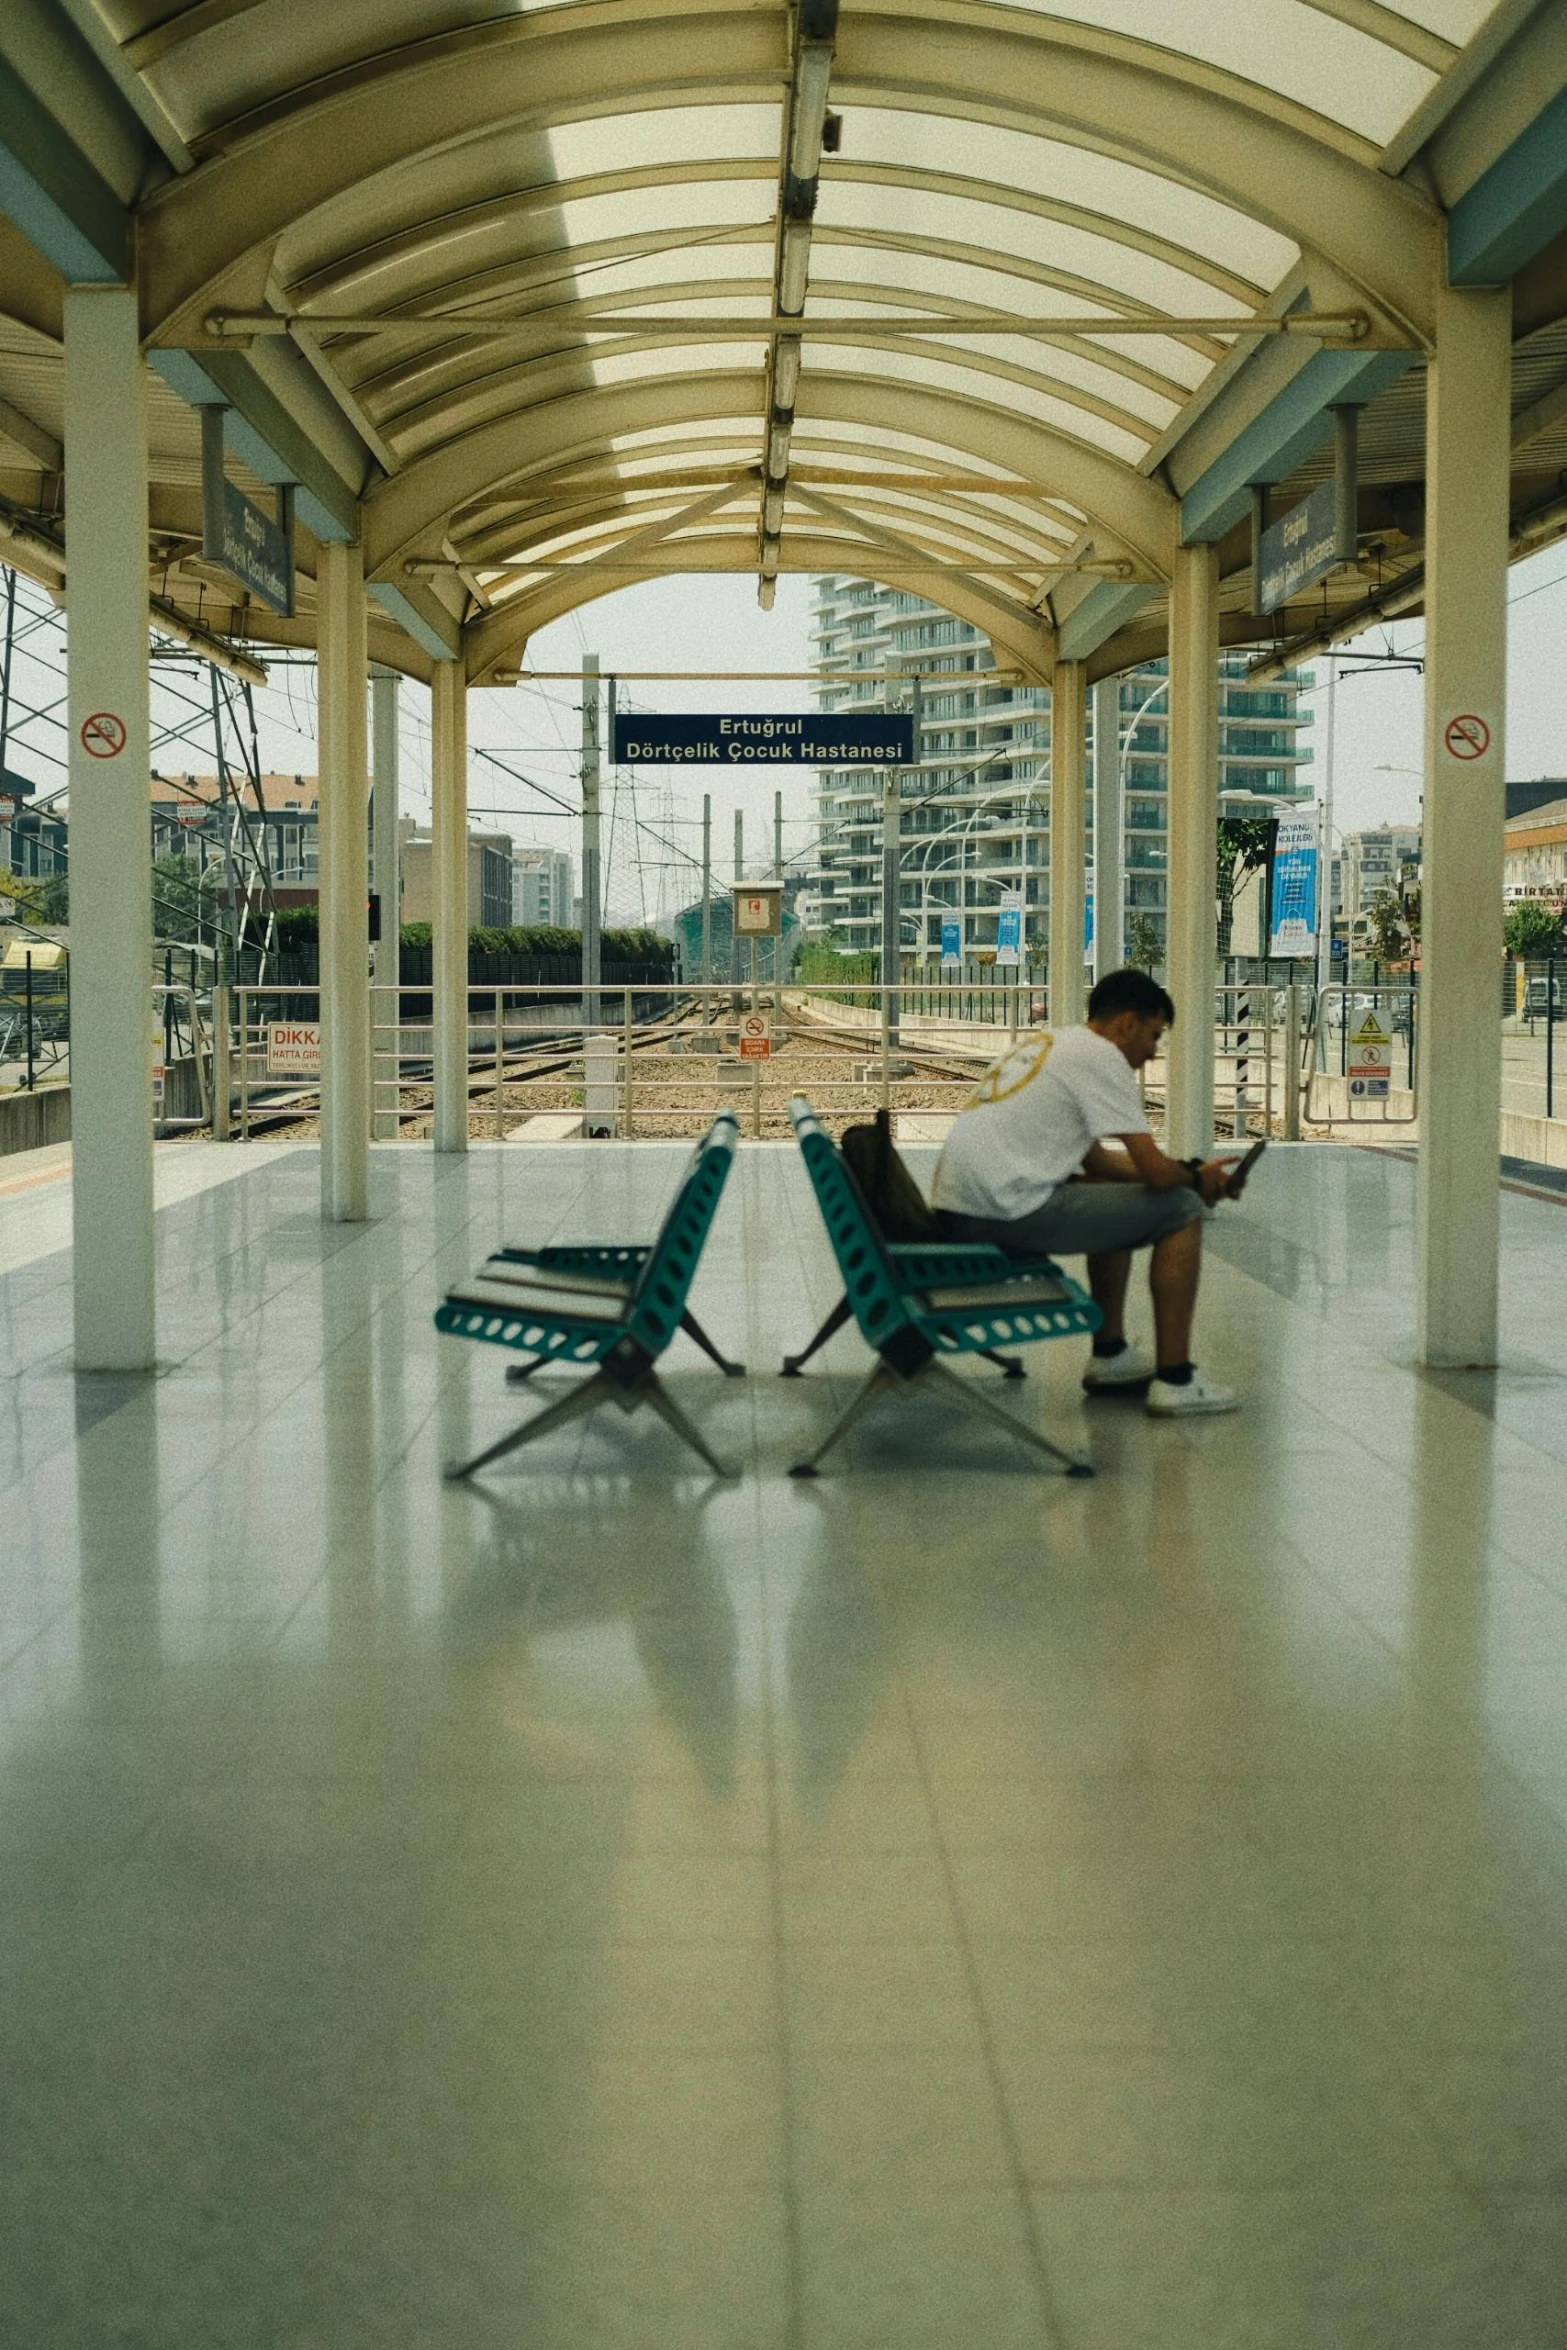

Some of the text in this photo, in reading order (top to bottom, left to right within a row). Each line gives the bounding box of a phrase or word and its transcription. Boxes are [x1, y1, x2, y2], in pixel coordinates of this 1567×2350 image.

[720, 718, 802, 738] Ertuğrul
[626, 742, 902, 762] Dörtçelik Çocuk Hastanesi
[275, 1027, 321, 1045] DİKK
[272, 1049, 321, 1059] HATTA GİR
